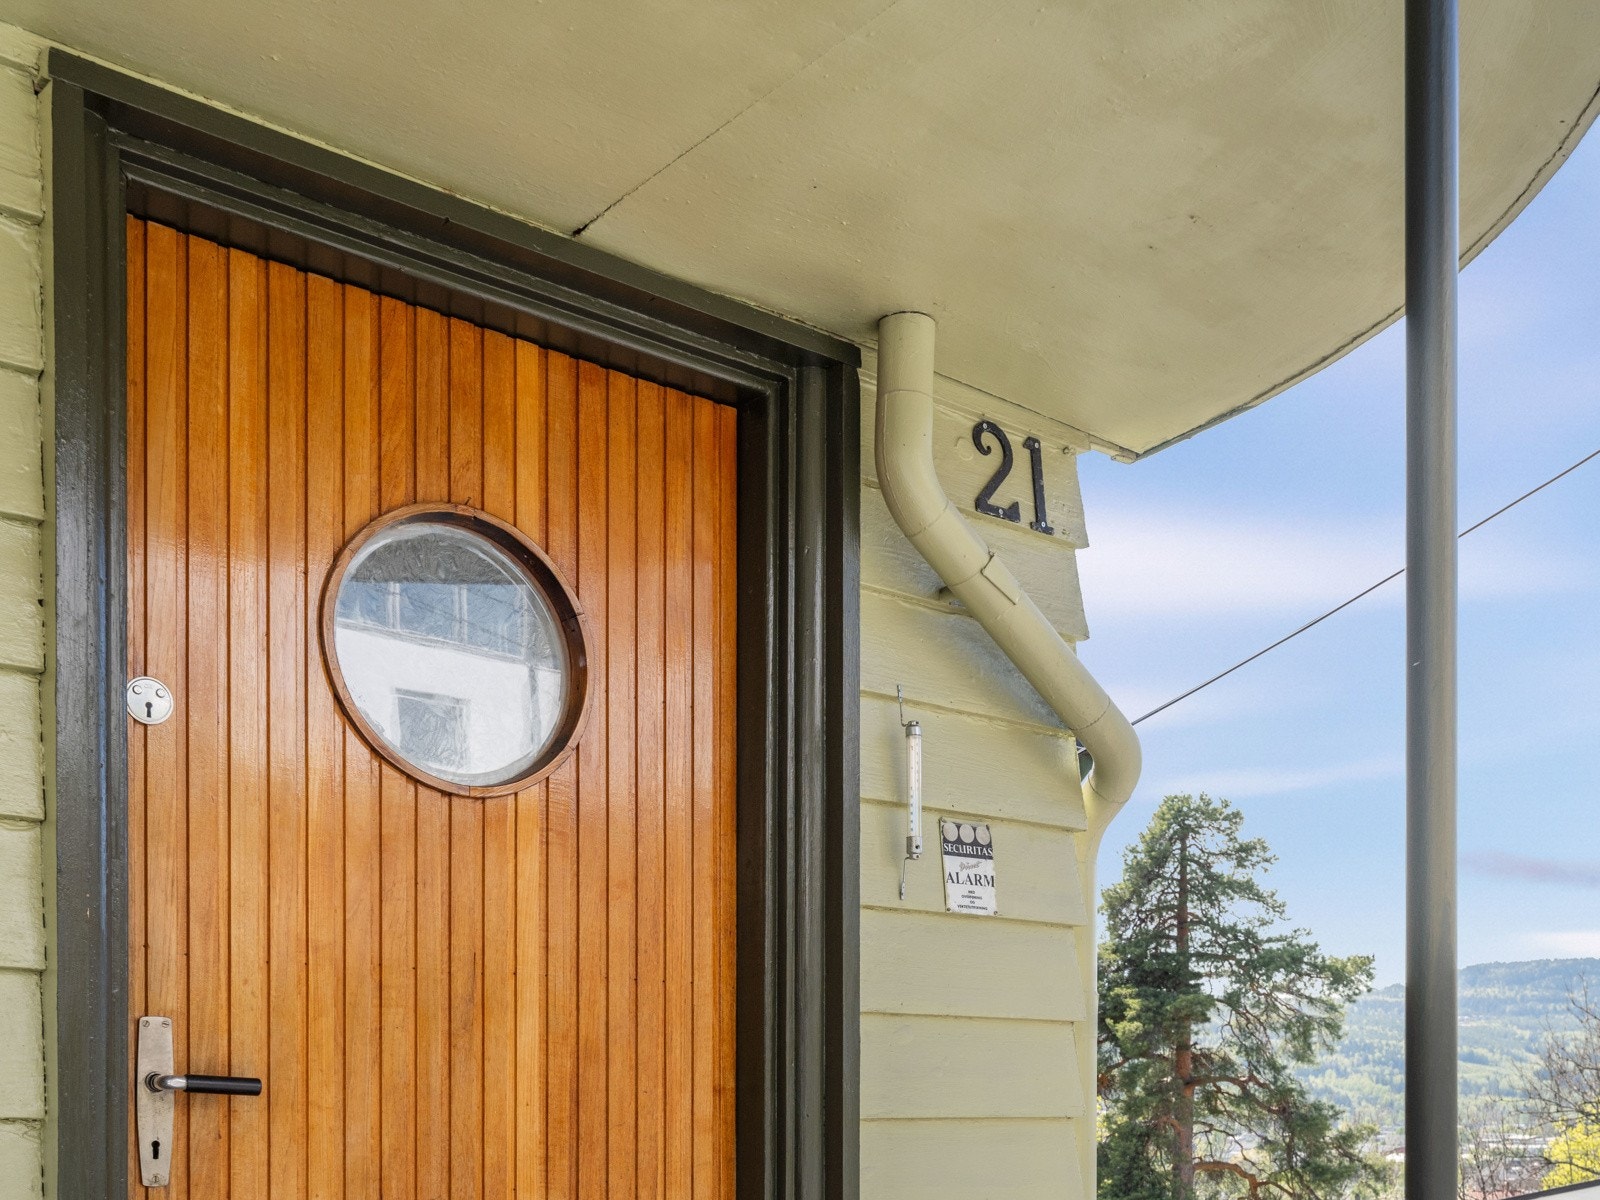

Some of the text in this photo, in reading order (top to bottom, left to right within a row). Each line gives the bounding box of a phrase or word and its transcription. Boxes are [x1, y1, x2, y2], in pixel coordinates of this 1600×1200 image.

[972, 420, 1054, 535] 21
[943, 843, 993, 856] SECURITAS
[946, 871, 995, 887] ALARM
